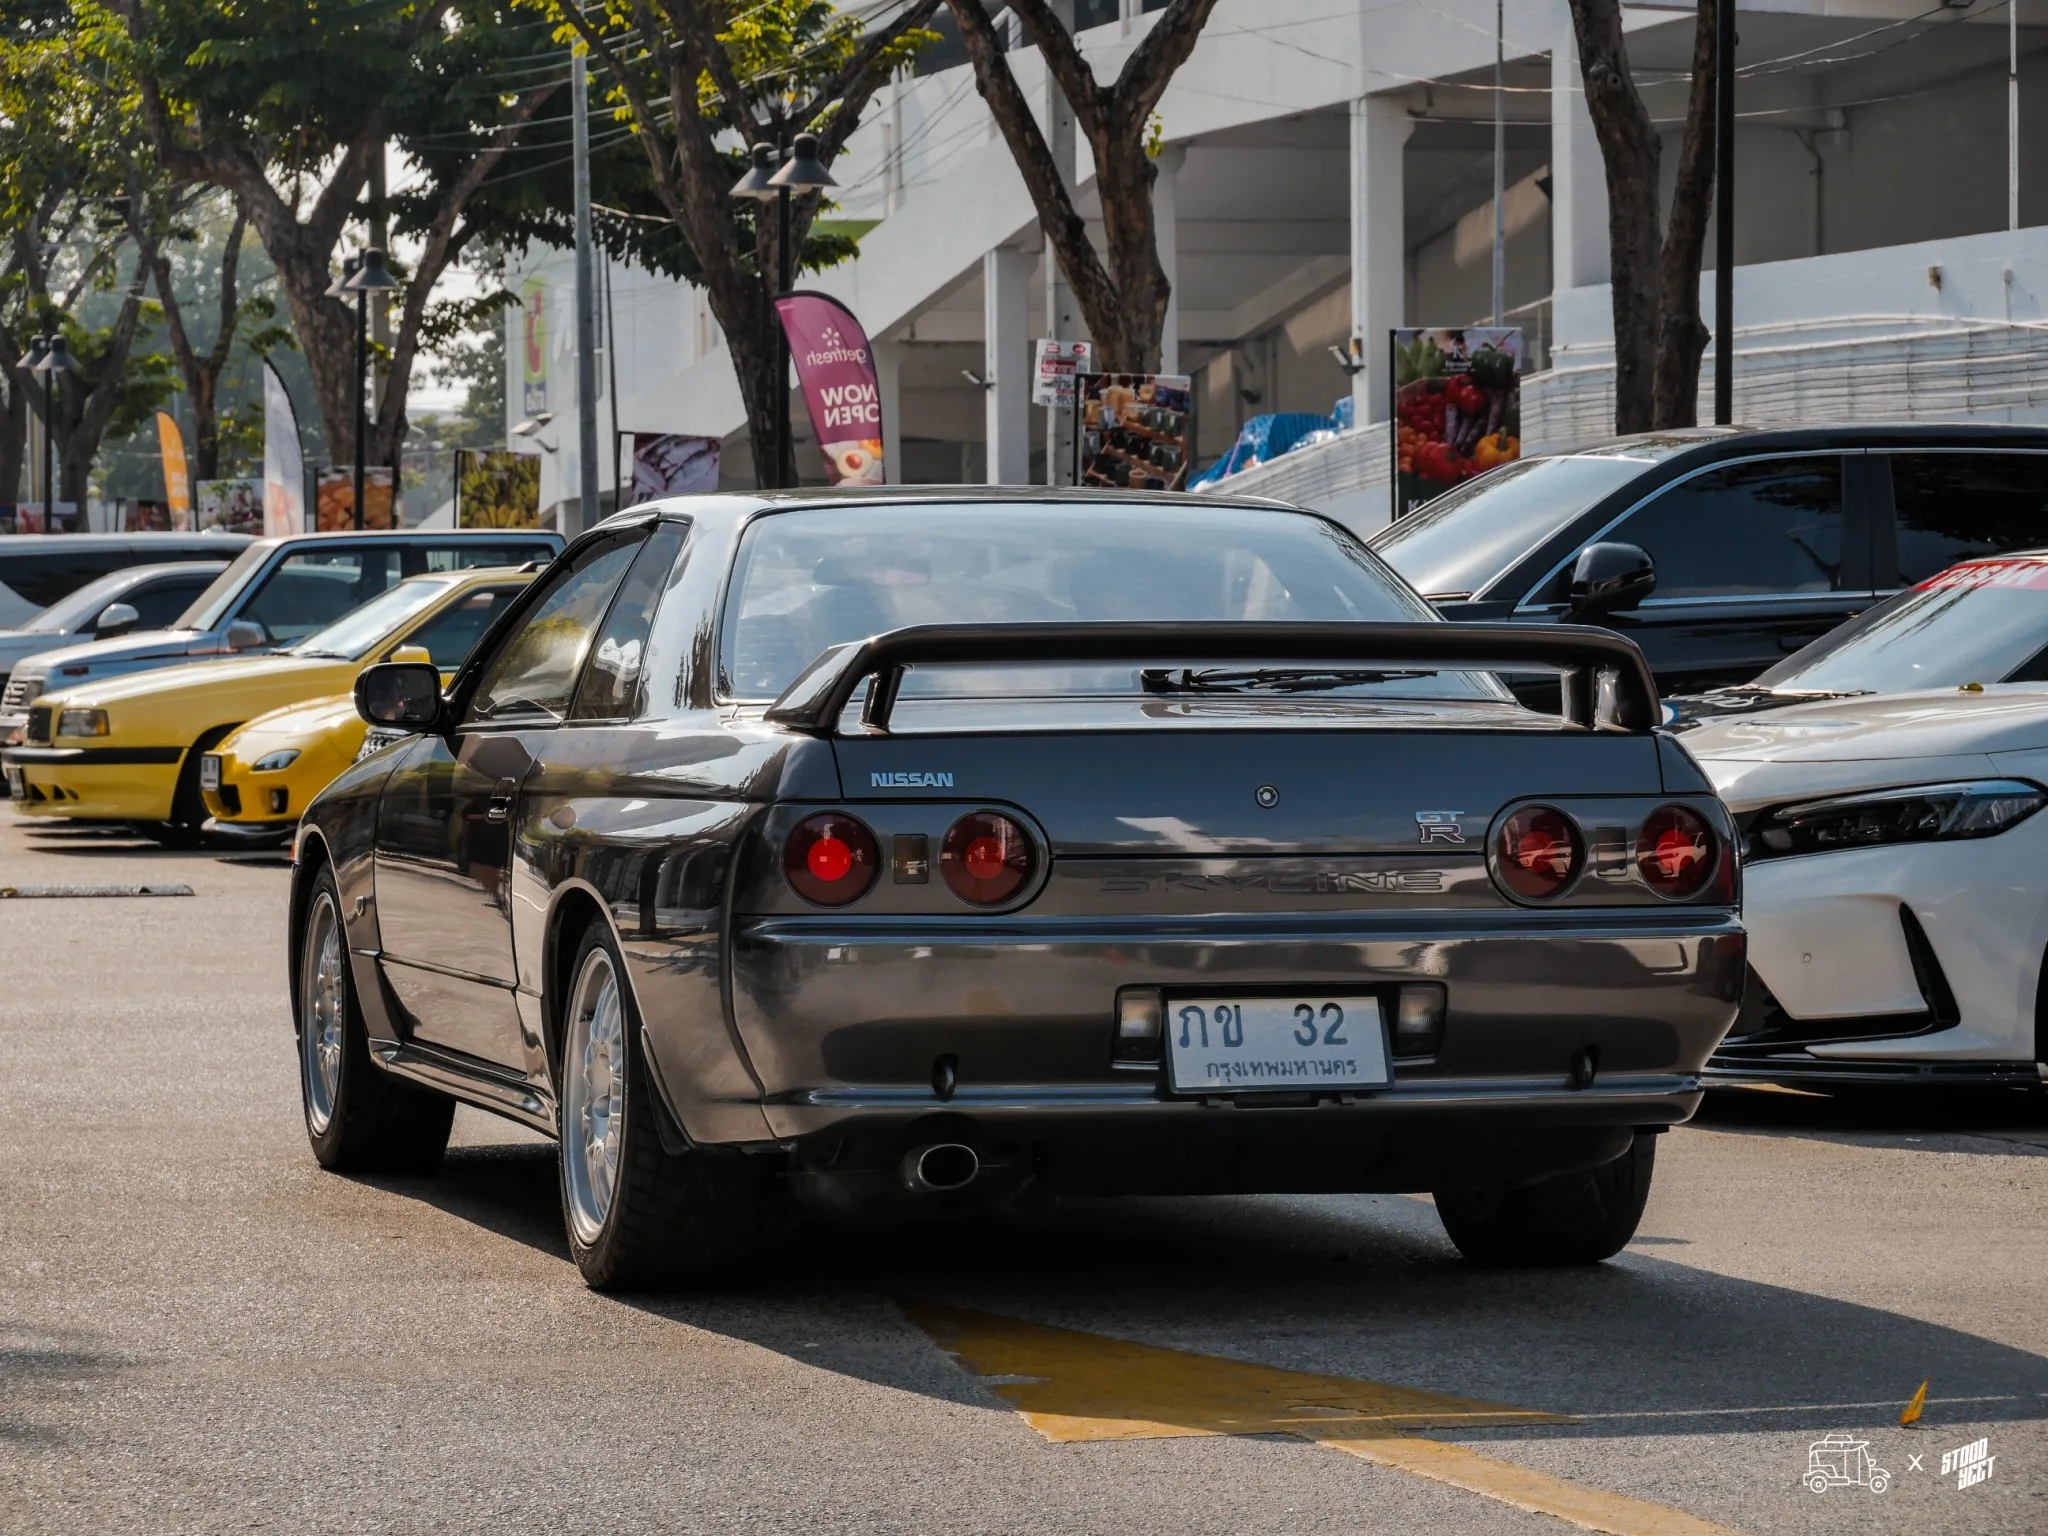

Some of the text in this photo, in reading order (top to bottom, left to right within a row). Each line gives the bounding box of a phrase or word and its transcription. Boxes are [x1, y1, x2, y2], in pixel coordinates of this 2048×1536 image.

[871, 773, 954, 787] NISSAN
[1100, 871, 1443, 892] SKYLINE
[1178, 1003, 1348, 1048] ภข 32
[1206, 1059, 1358, 1083] กรุงเทพมหานคร
